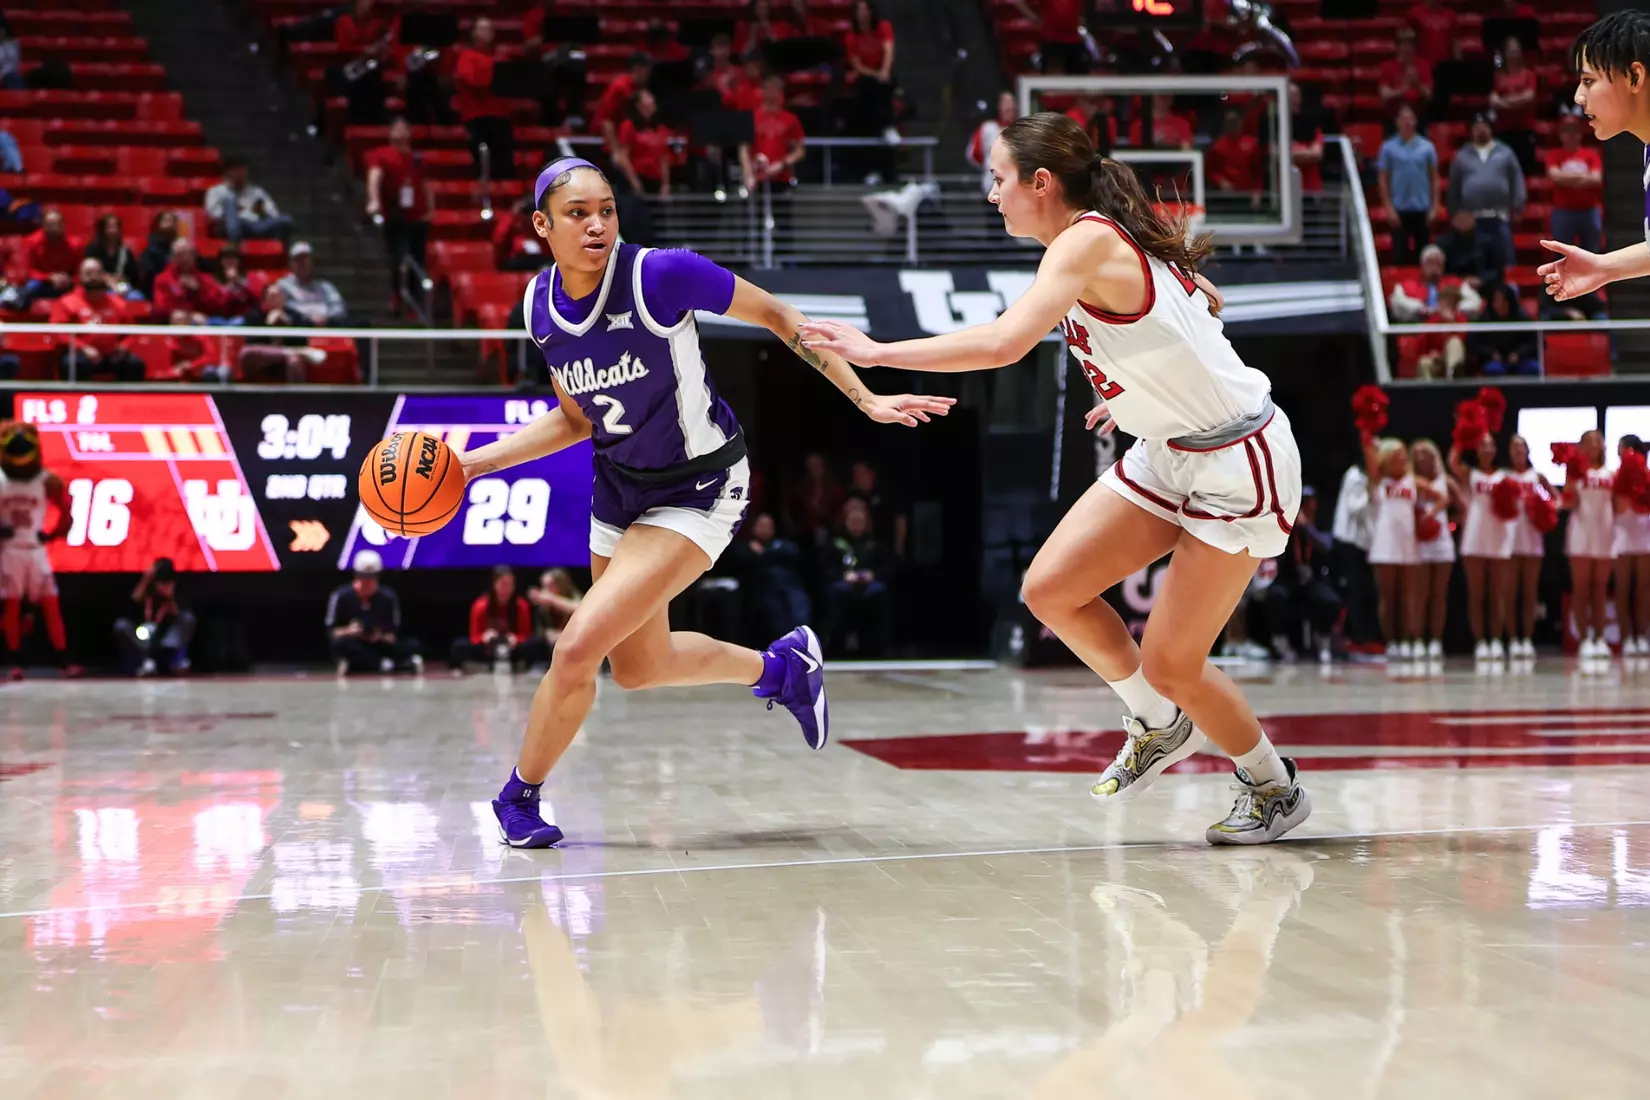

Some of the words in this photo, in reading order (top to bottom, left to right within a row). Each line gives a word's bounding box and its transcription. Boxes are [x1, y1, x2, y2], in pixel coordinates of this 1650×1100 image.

[606, 310, 634, 331] XII
[550, 350, 650, 395] Wildcats
[22, 398, 68, 424] FLS
[592, 394, 633, 434] 2
[257, 414, 351, 459] 3:04
[415, 436, 438, 480] NCAA
[66, 478, 134, 546] 16
[462, 477, 551, 545] 29
